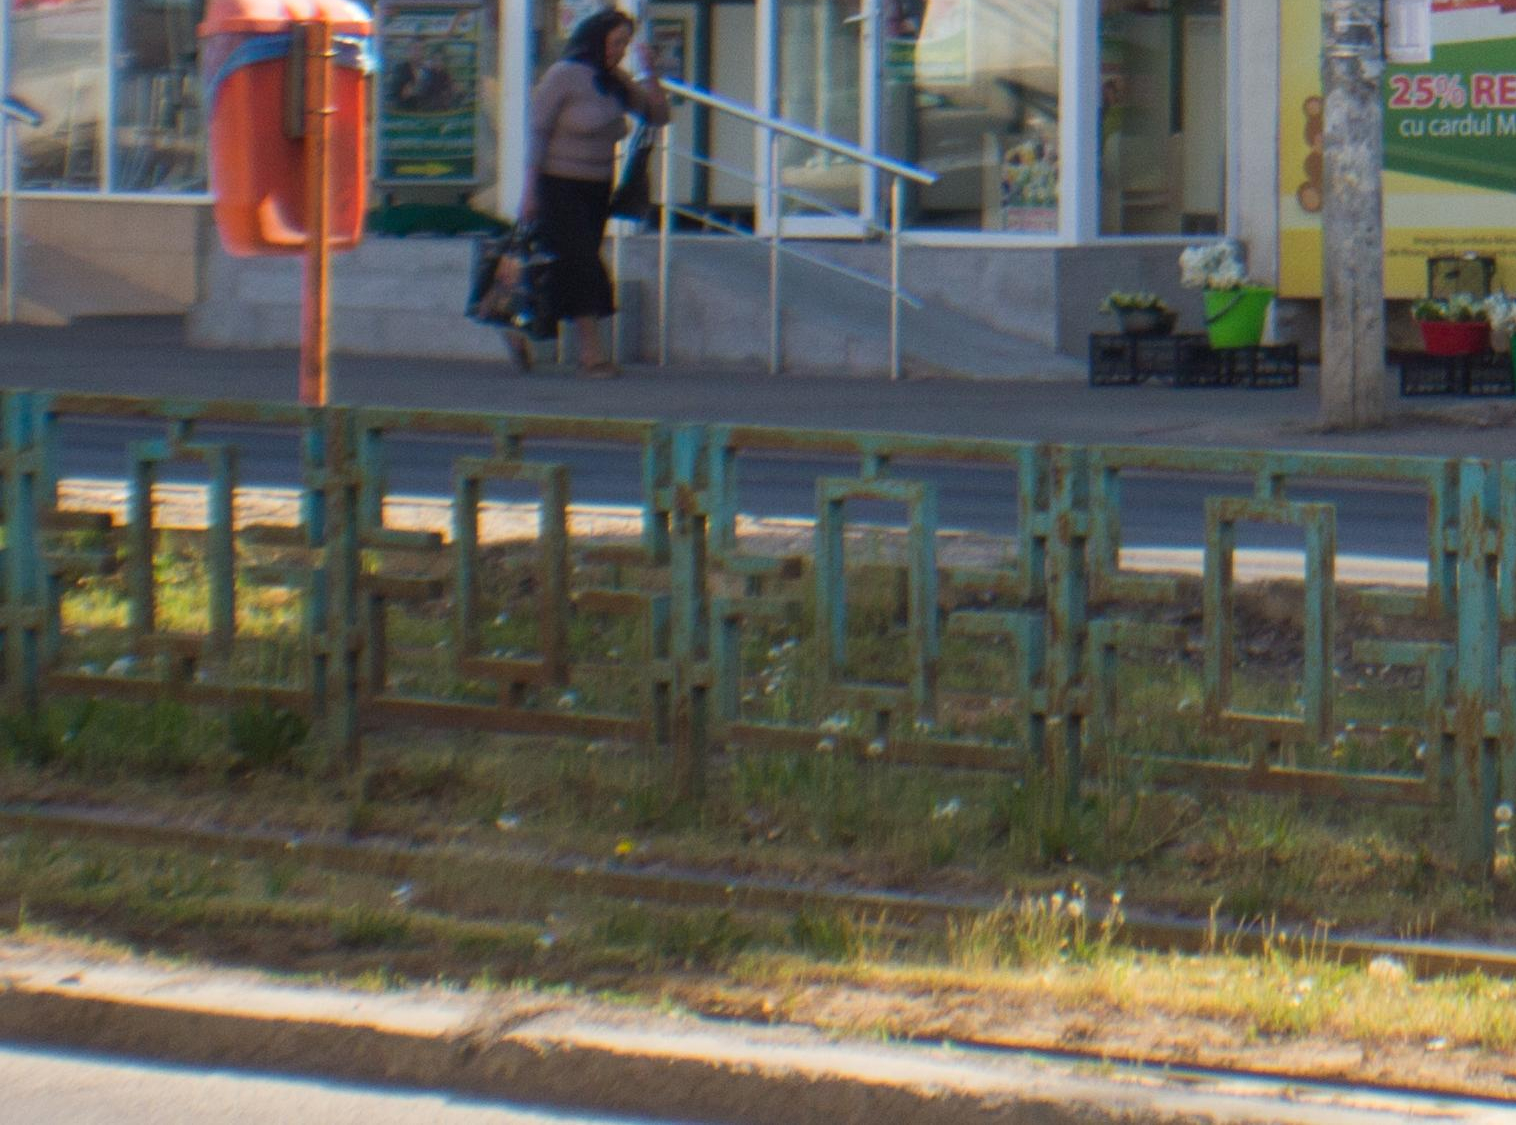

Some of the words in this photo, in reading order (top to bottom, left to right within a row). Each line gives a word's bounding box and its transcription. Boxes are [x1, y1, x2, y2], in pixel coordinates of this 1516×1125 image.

[1388, 73, 1467, 109] 25%
[1399, 120, 1425, 138] cu
[1428, 114, 1491, 138] cardul
